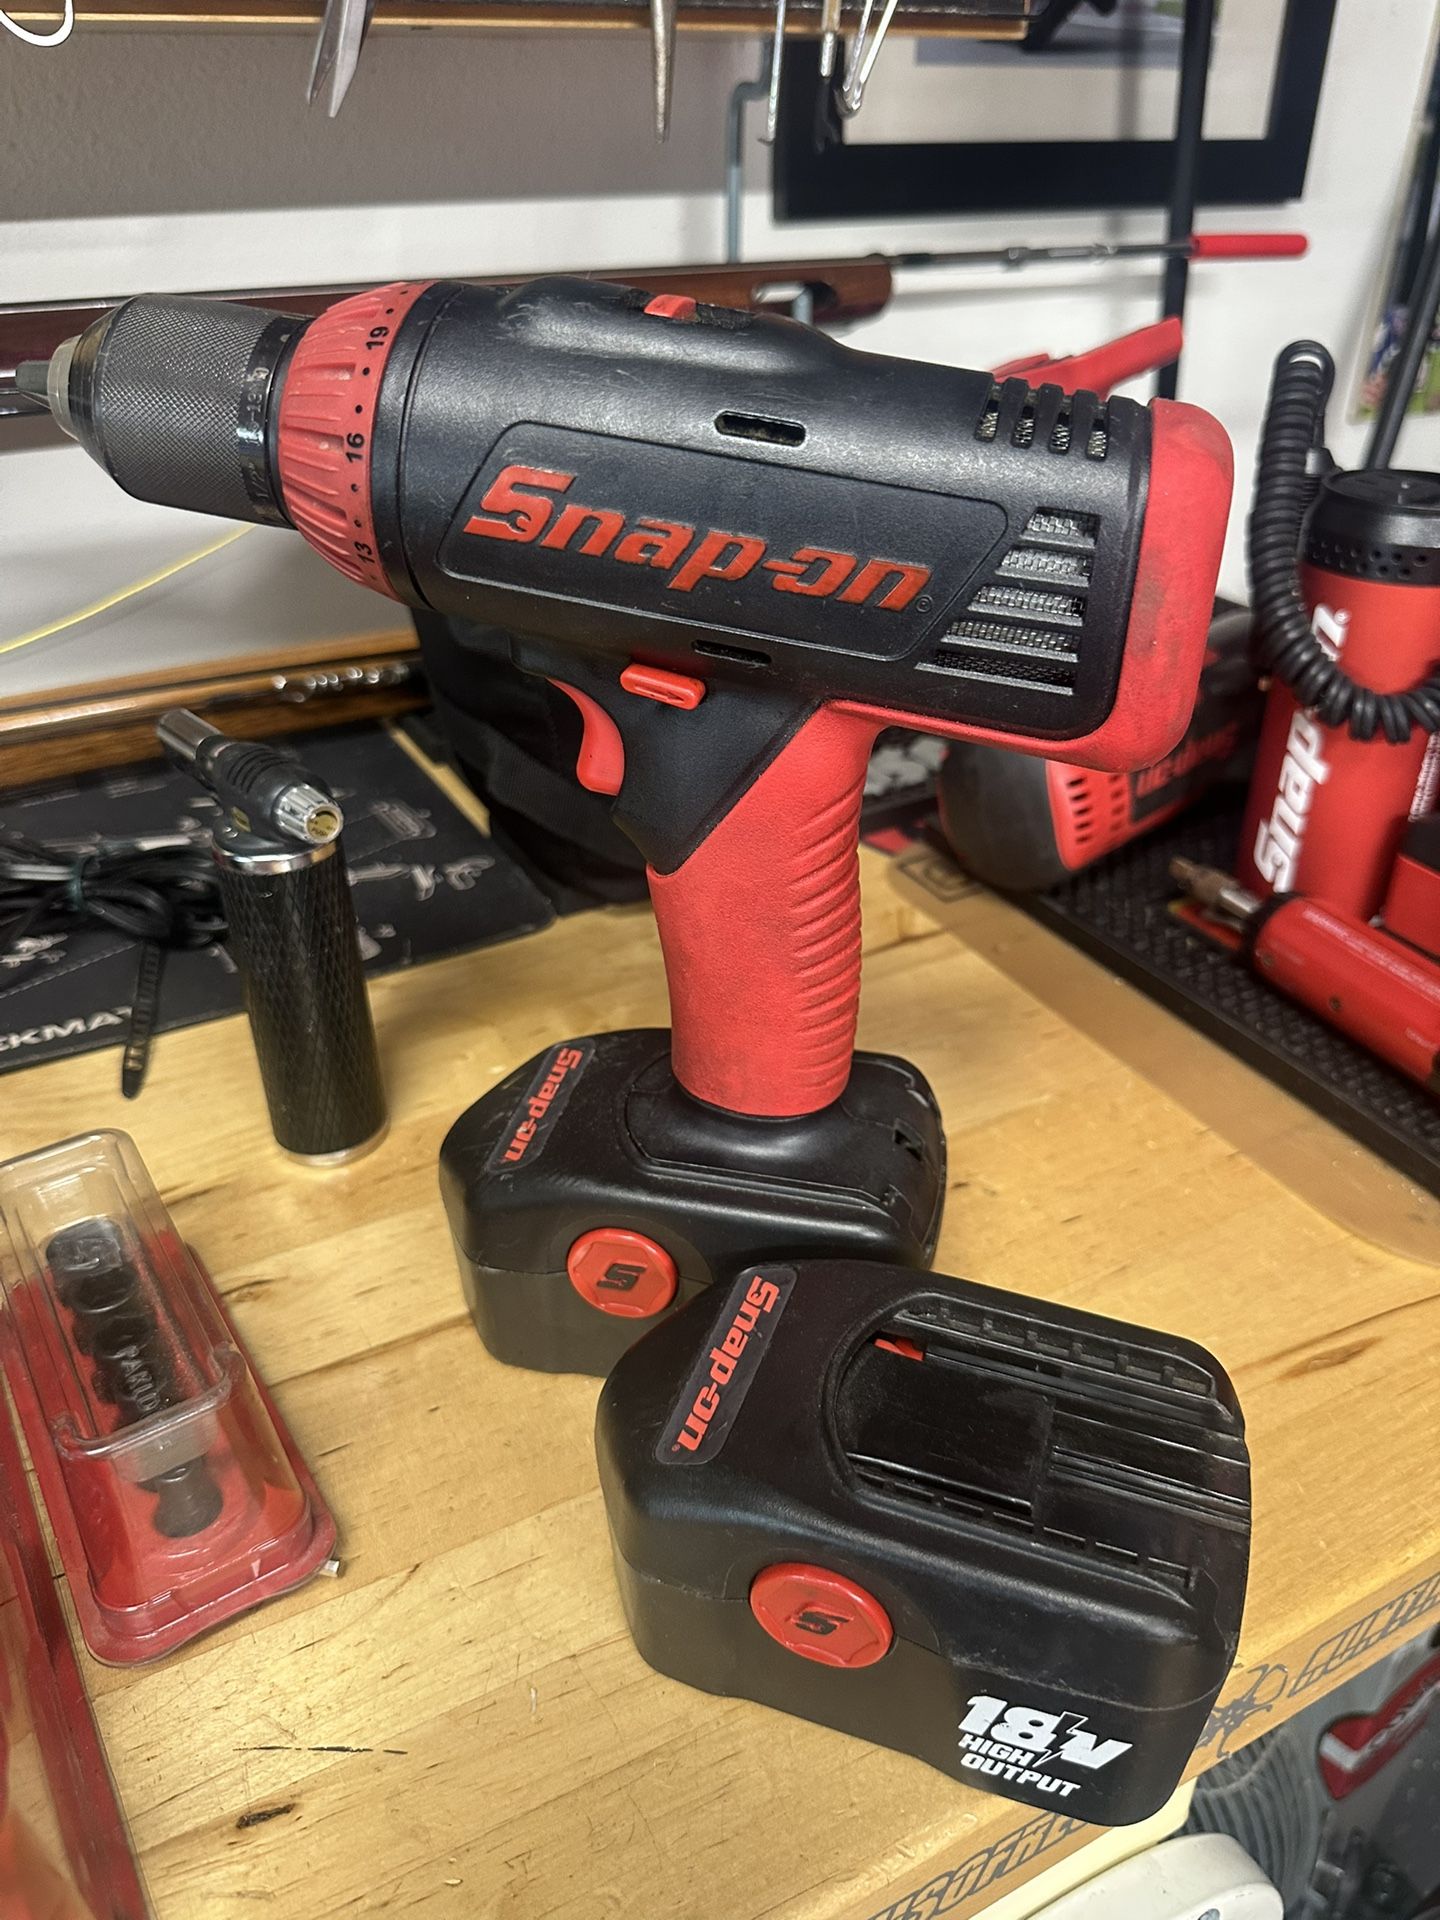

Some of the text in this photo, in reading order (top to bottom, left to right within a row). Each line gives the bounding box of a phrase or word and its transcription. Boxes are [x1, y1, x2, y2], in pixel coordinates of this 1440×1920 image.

[365, 326, 389, 350] 19
[345, 432, 365, 463] 16
[354, 540, 376, 565] 13
[463, 464, 932, 613] Snap-on
[504, 1047, 583, 1161] Snap-on
[677, 1275, 780, 1451] Snap-on
[958, 1695, 1134, 1770] 18V
[958, 1733, 1035, 1767] HIGH
[961, 1752, 1082, 1797] OUTPUT
